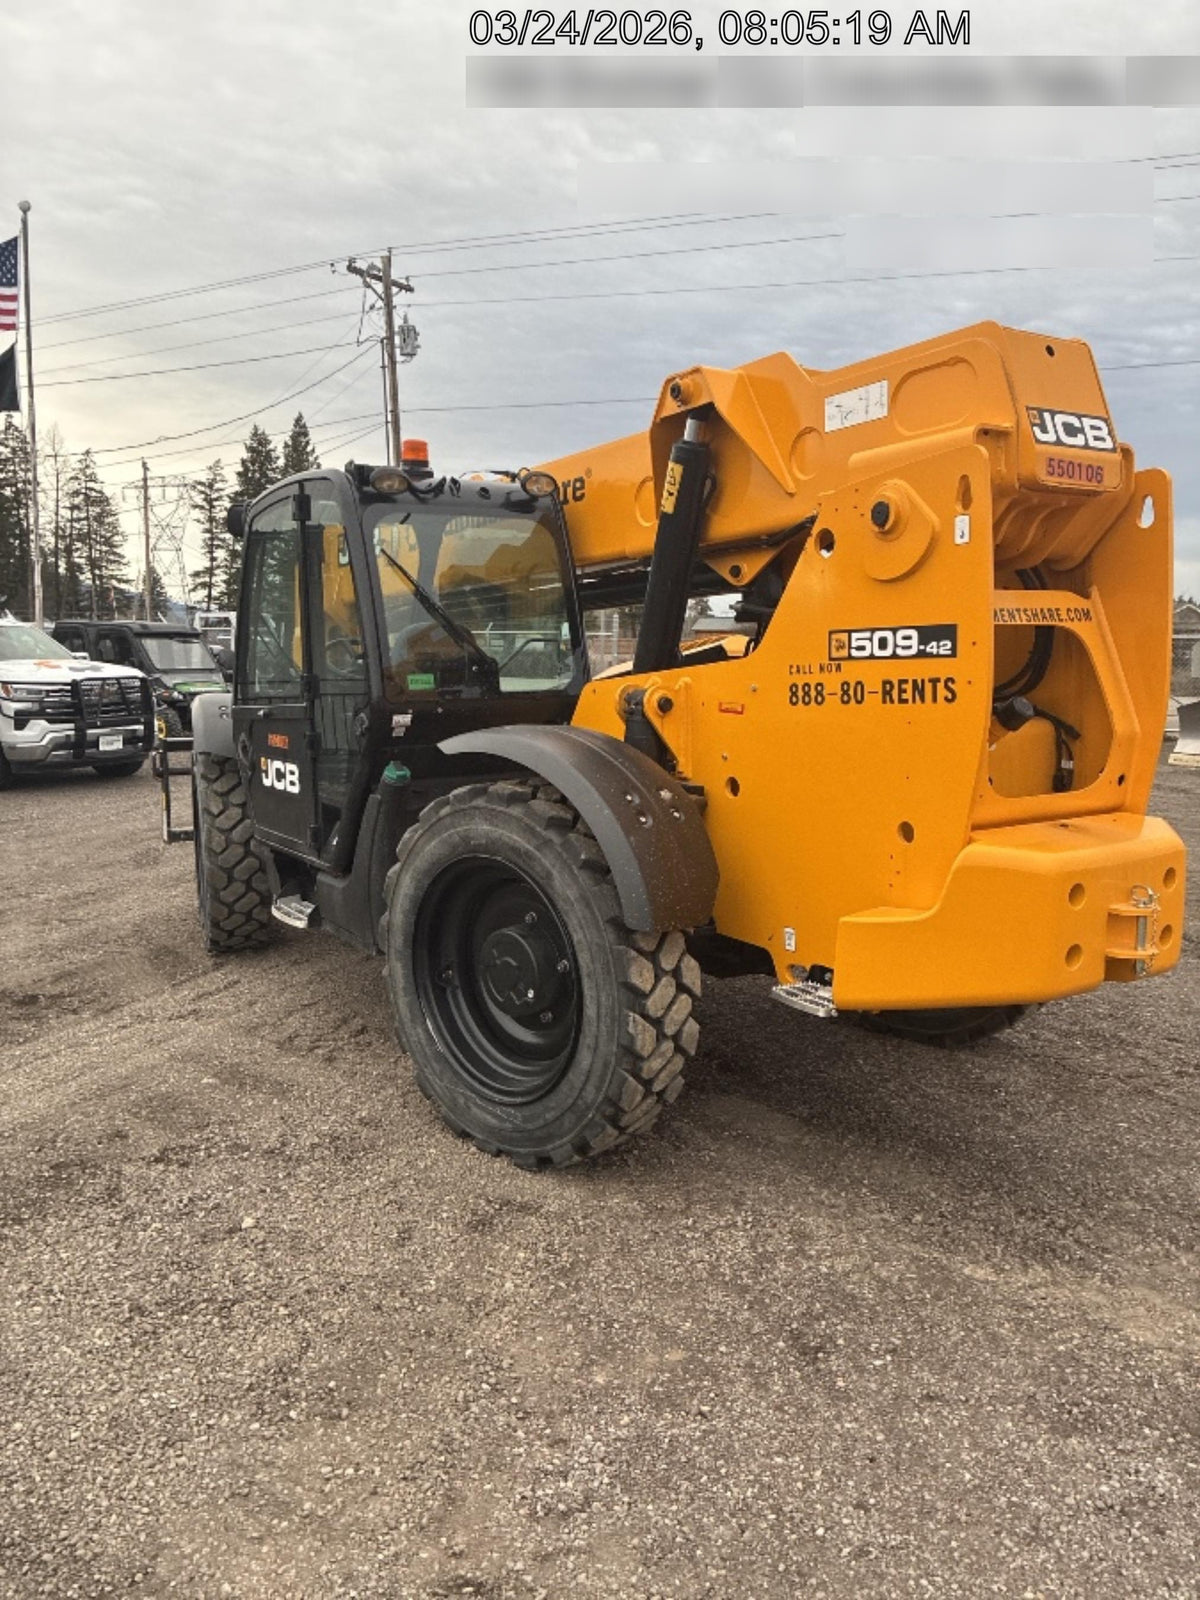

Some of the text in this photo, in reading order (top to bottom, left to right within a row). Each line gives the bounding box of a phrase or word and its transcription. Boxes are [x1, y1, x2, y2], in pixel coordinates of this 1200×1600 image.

[1032, 411, 1114, 449] JCB
[1046, 457, 1104, 484] 550106
[850, 628, 953, 658] 509-42
[789, 662, 842, 676] CALL NOW
[789, 676, 958, 706] 888-80-RENTS
[261, 758, 300, 794] JCB
